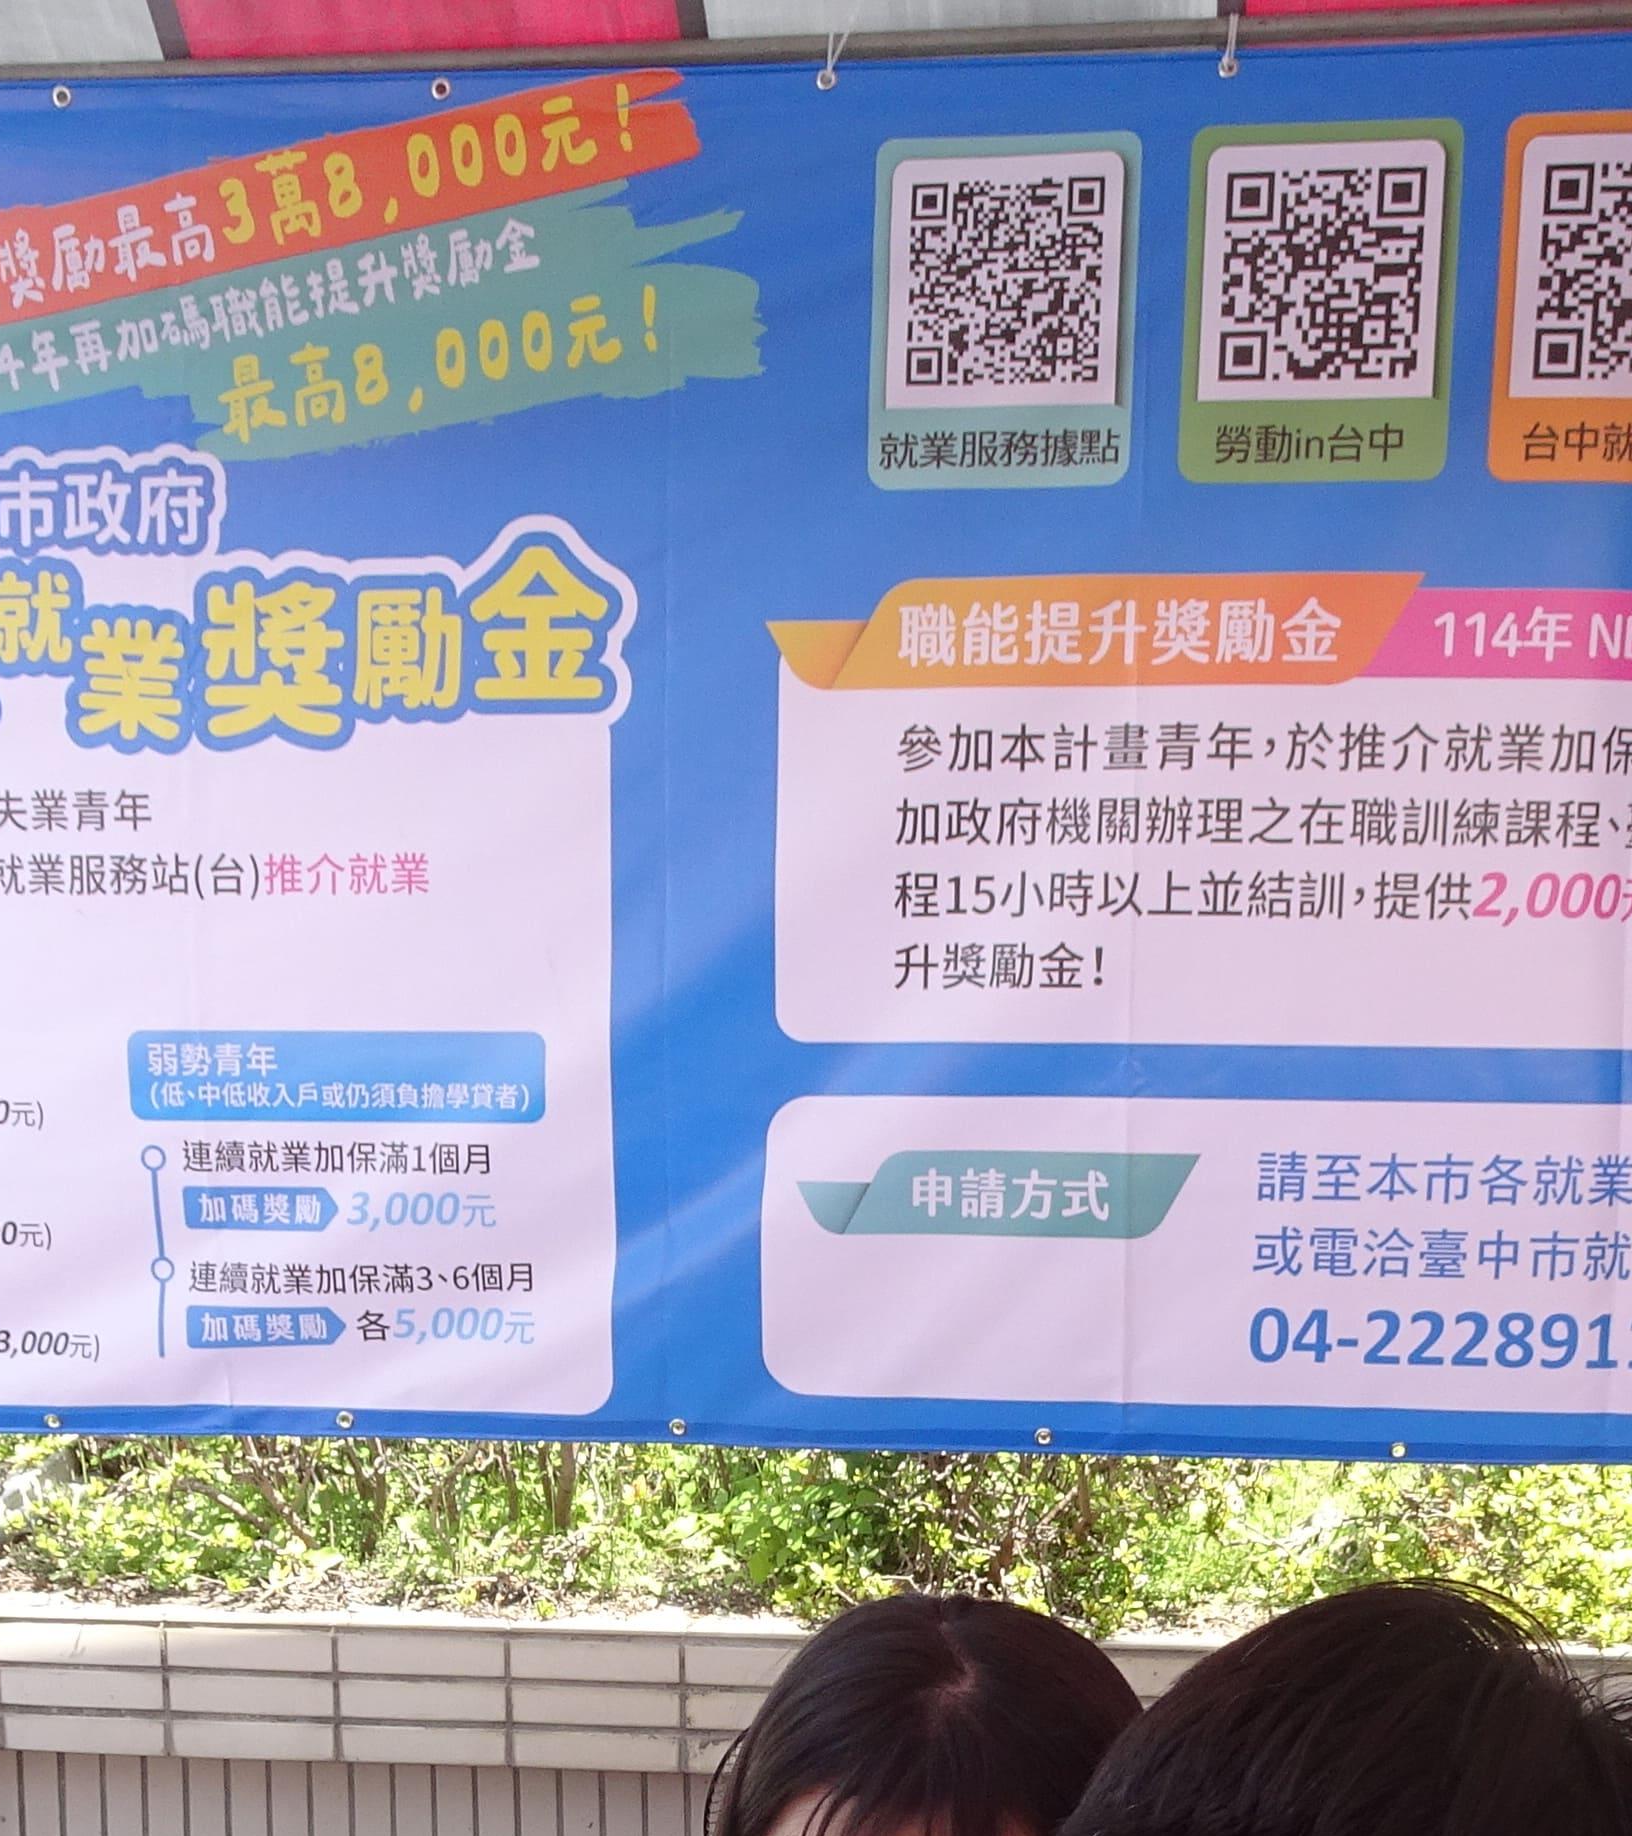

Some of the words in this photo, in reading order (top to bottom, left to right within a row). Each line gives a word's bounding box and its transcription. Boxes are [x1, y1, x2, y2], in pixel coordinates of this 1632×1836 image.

[218, 285, 660, 441] 最高8,000元!
[879, 429, 1121, 469] 就業服務據點
[1215, 422, 1405, 464] 勞動in台中
[897, 596, 1342, 669] 職能提升獎勵金
[1434, 607, 1572, 661] 114年
[894, 942, 1105, 990] 升獎勵金!
[147, 1043, 279, 1077] 弱勢青年
[182, 1141, 492, 1175] 連續就業加保滿1個月
[198, 1192, 322, 1226] 加碼獎勵
[346, 1191, 497, 1232] 3,000元
[911, 1167, 1111, 1222] 申請方式
[188, 1261, 535, 1296] 連續就業加保滿3、6個月
[201, 1310, 329, 1343] 加碼獎勵
